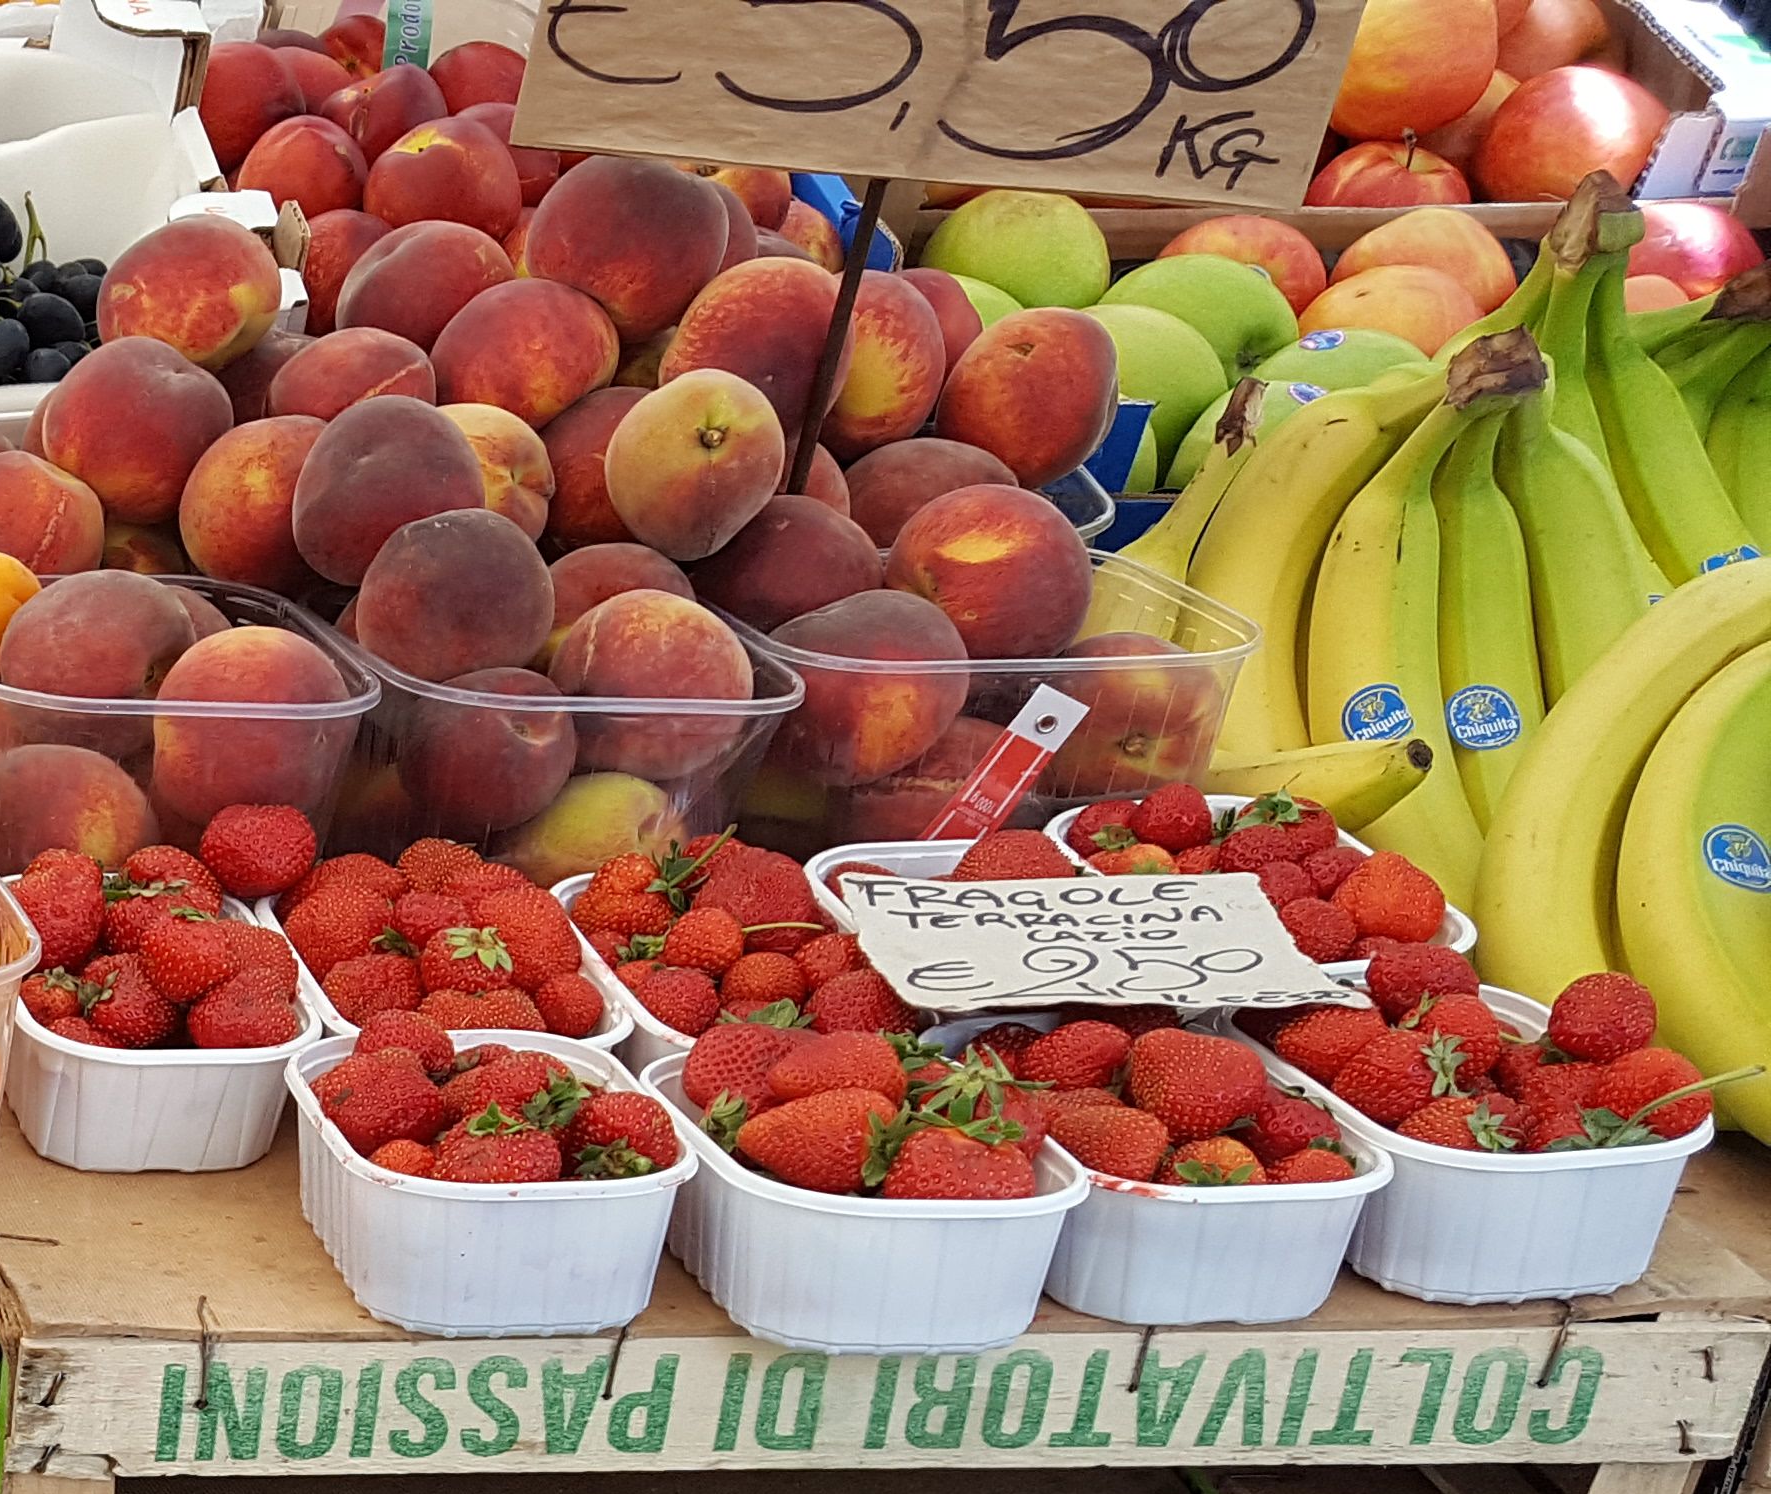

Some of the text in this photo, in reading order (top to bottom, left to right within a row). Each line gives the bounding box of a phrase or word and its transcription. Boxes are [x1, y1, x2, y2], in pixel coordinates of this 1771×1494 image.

[392, 0, 421, 65] Prodo
[1156, 110, 1281, 190] KG
[1455, 717, 1519, 740] Chiquita
[845, 877, 1199, 911] FRAGOLE
[887, 904, 1225, 930] TERRACINA
[154, 1346, 1606, 1464] COLTIVATORI DI PASSIONI
